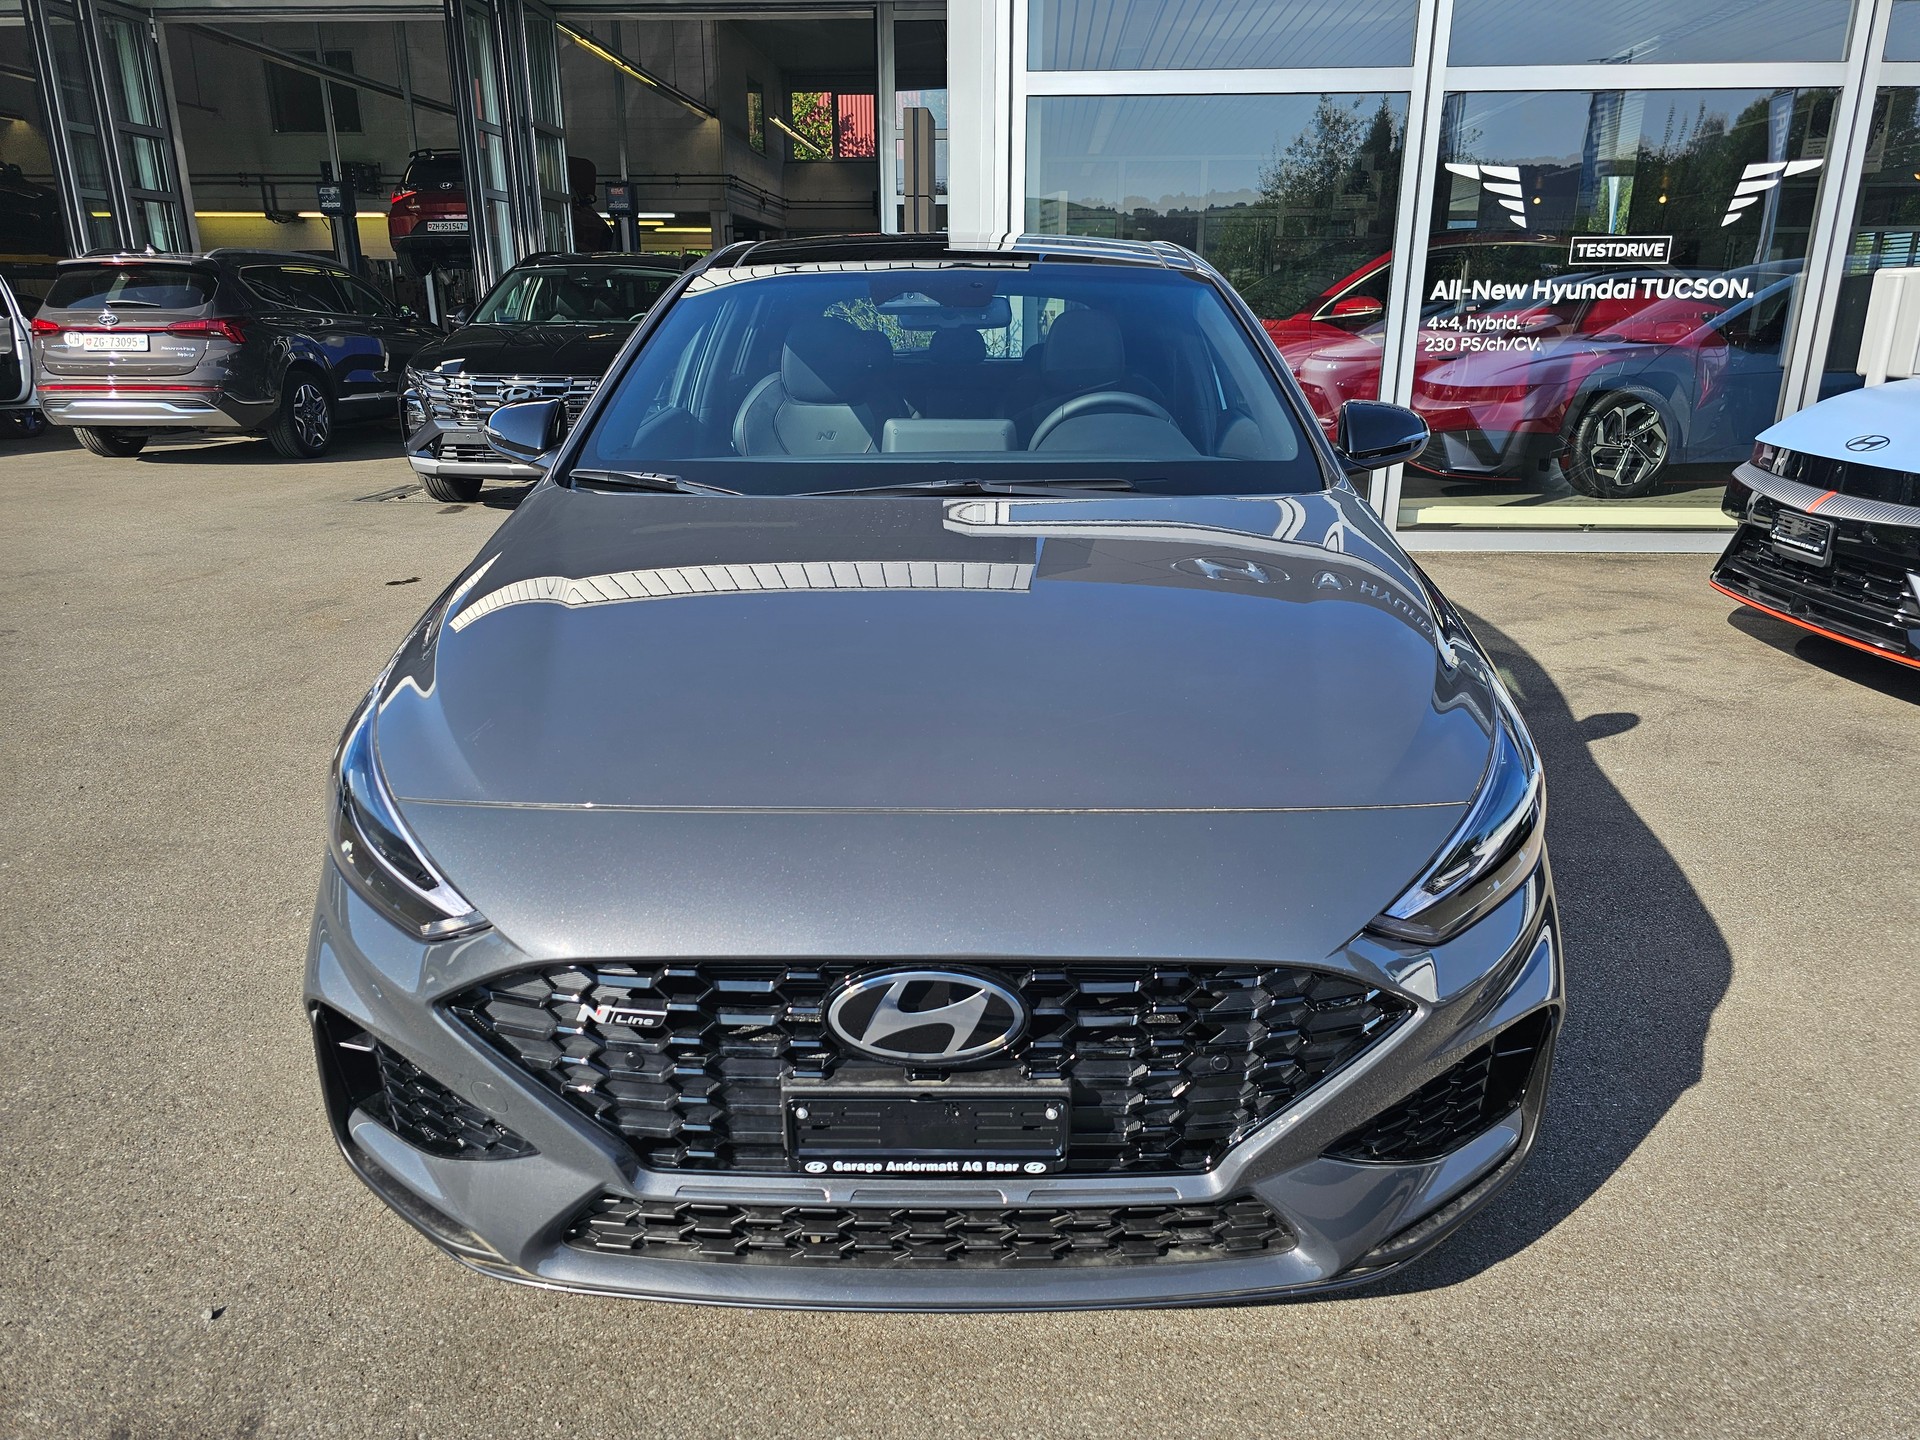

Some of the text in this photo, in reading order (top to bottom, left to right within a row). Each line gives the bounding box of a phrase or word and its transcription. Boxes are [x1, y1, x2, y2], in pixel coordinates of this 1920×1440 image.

[1577, 242, 1665, 258] TESTDRIVE
[1430, 277, 1754, 304] All-New Hyundai TUCSON.
[1466, 313, 1521, 332] hybrid.
[68, 333, 80, 345] CH
[1424, 335, 1541, 354] 230 PS/ch/CV.
[832, 1161, 1019, 1173] Garage Andermatt AG Baar
